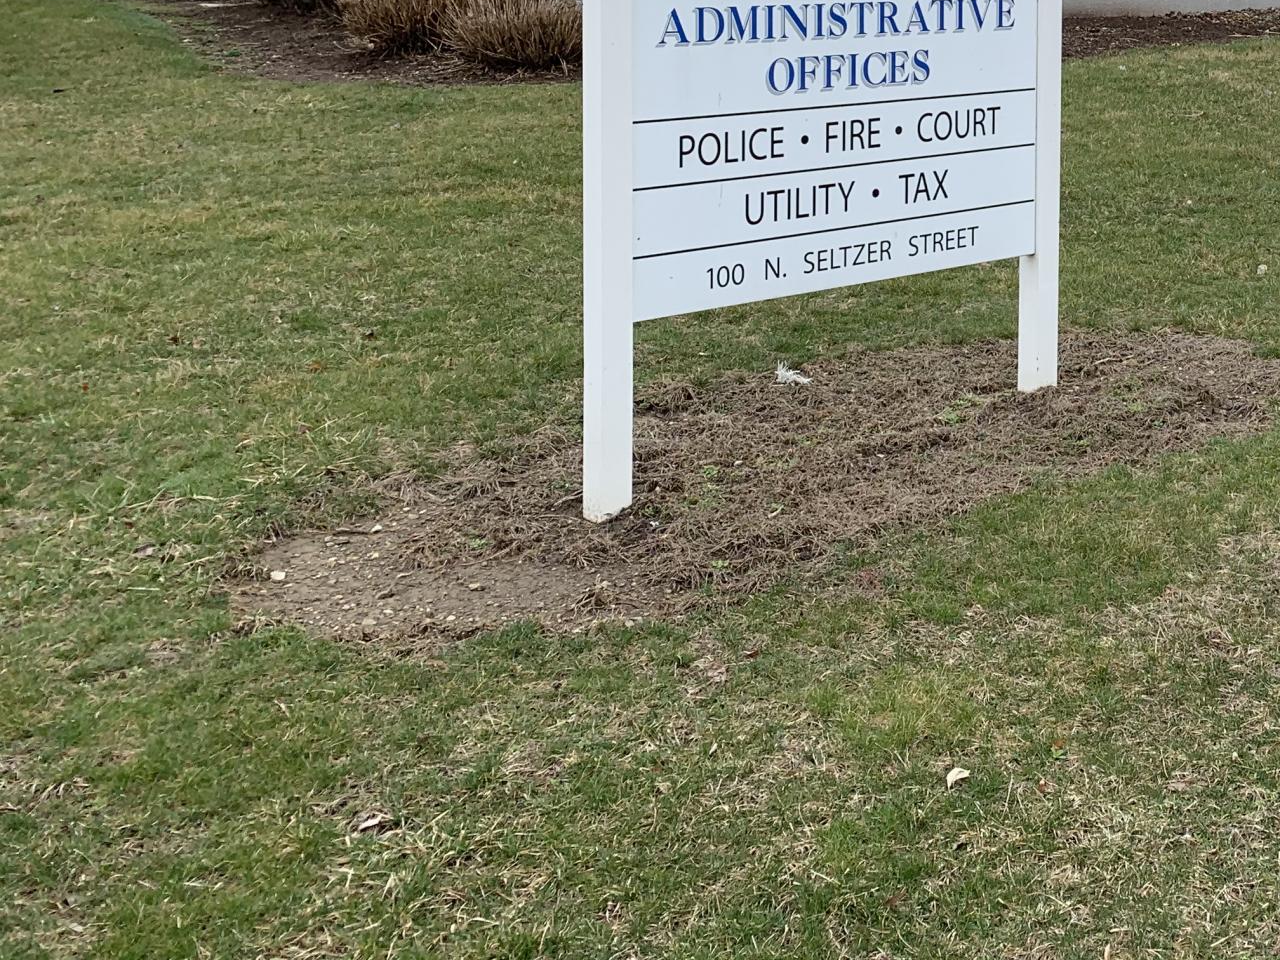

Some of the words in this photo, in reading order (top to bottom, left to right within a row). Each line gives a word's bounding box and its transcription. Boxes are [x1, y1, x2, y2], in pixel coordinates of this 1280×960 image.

[766, 49, 931, 96] OFFICES
[678, 126, 785, 168] POLICE
[824, 117, 882, 154] FIRE
[916, 106, 1002, 142] COURT
[743, 181, 856, 226] UTILITY
[899, 169, 950, 205] TAX
[706, 263, 746, 290] 100
[764, 256, 788, 281] N.
[802, 240, 893, 275] SELTZER
[907, 226, 980, 258] STREET
